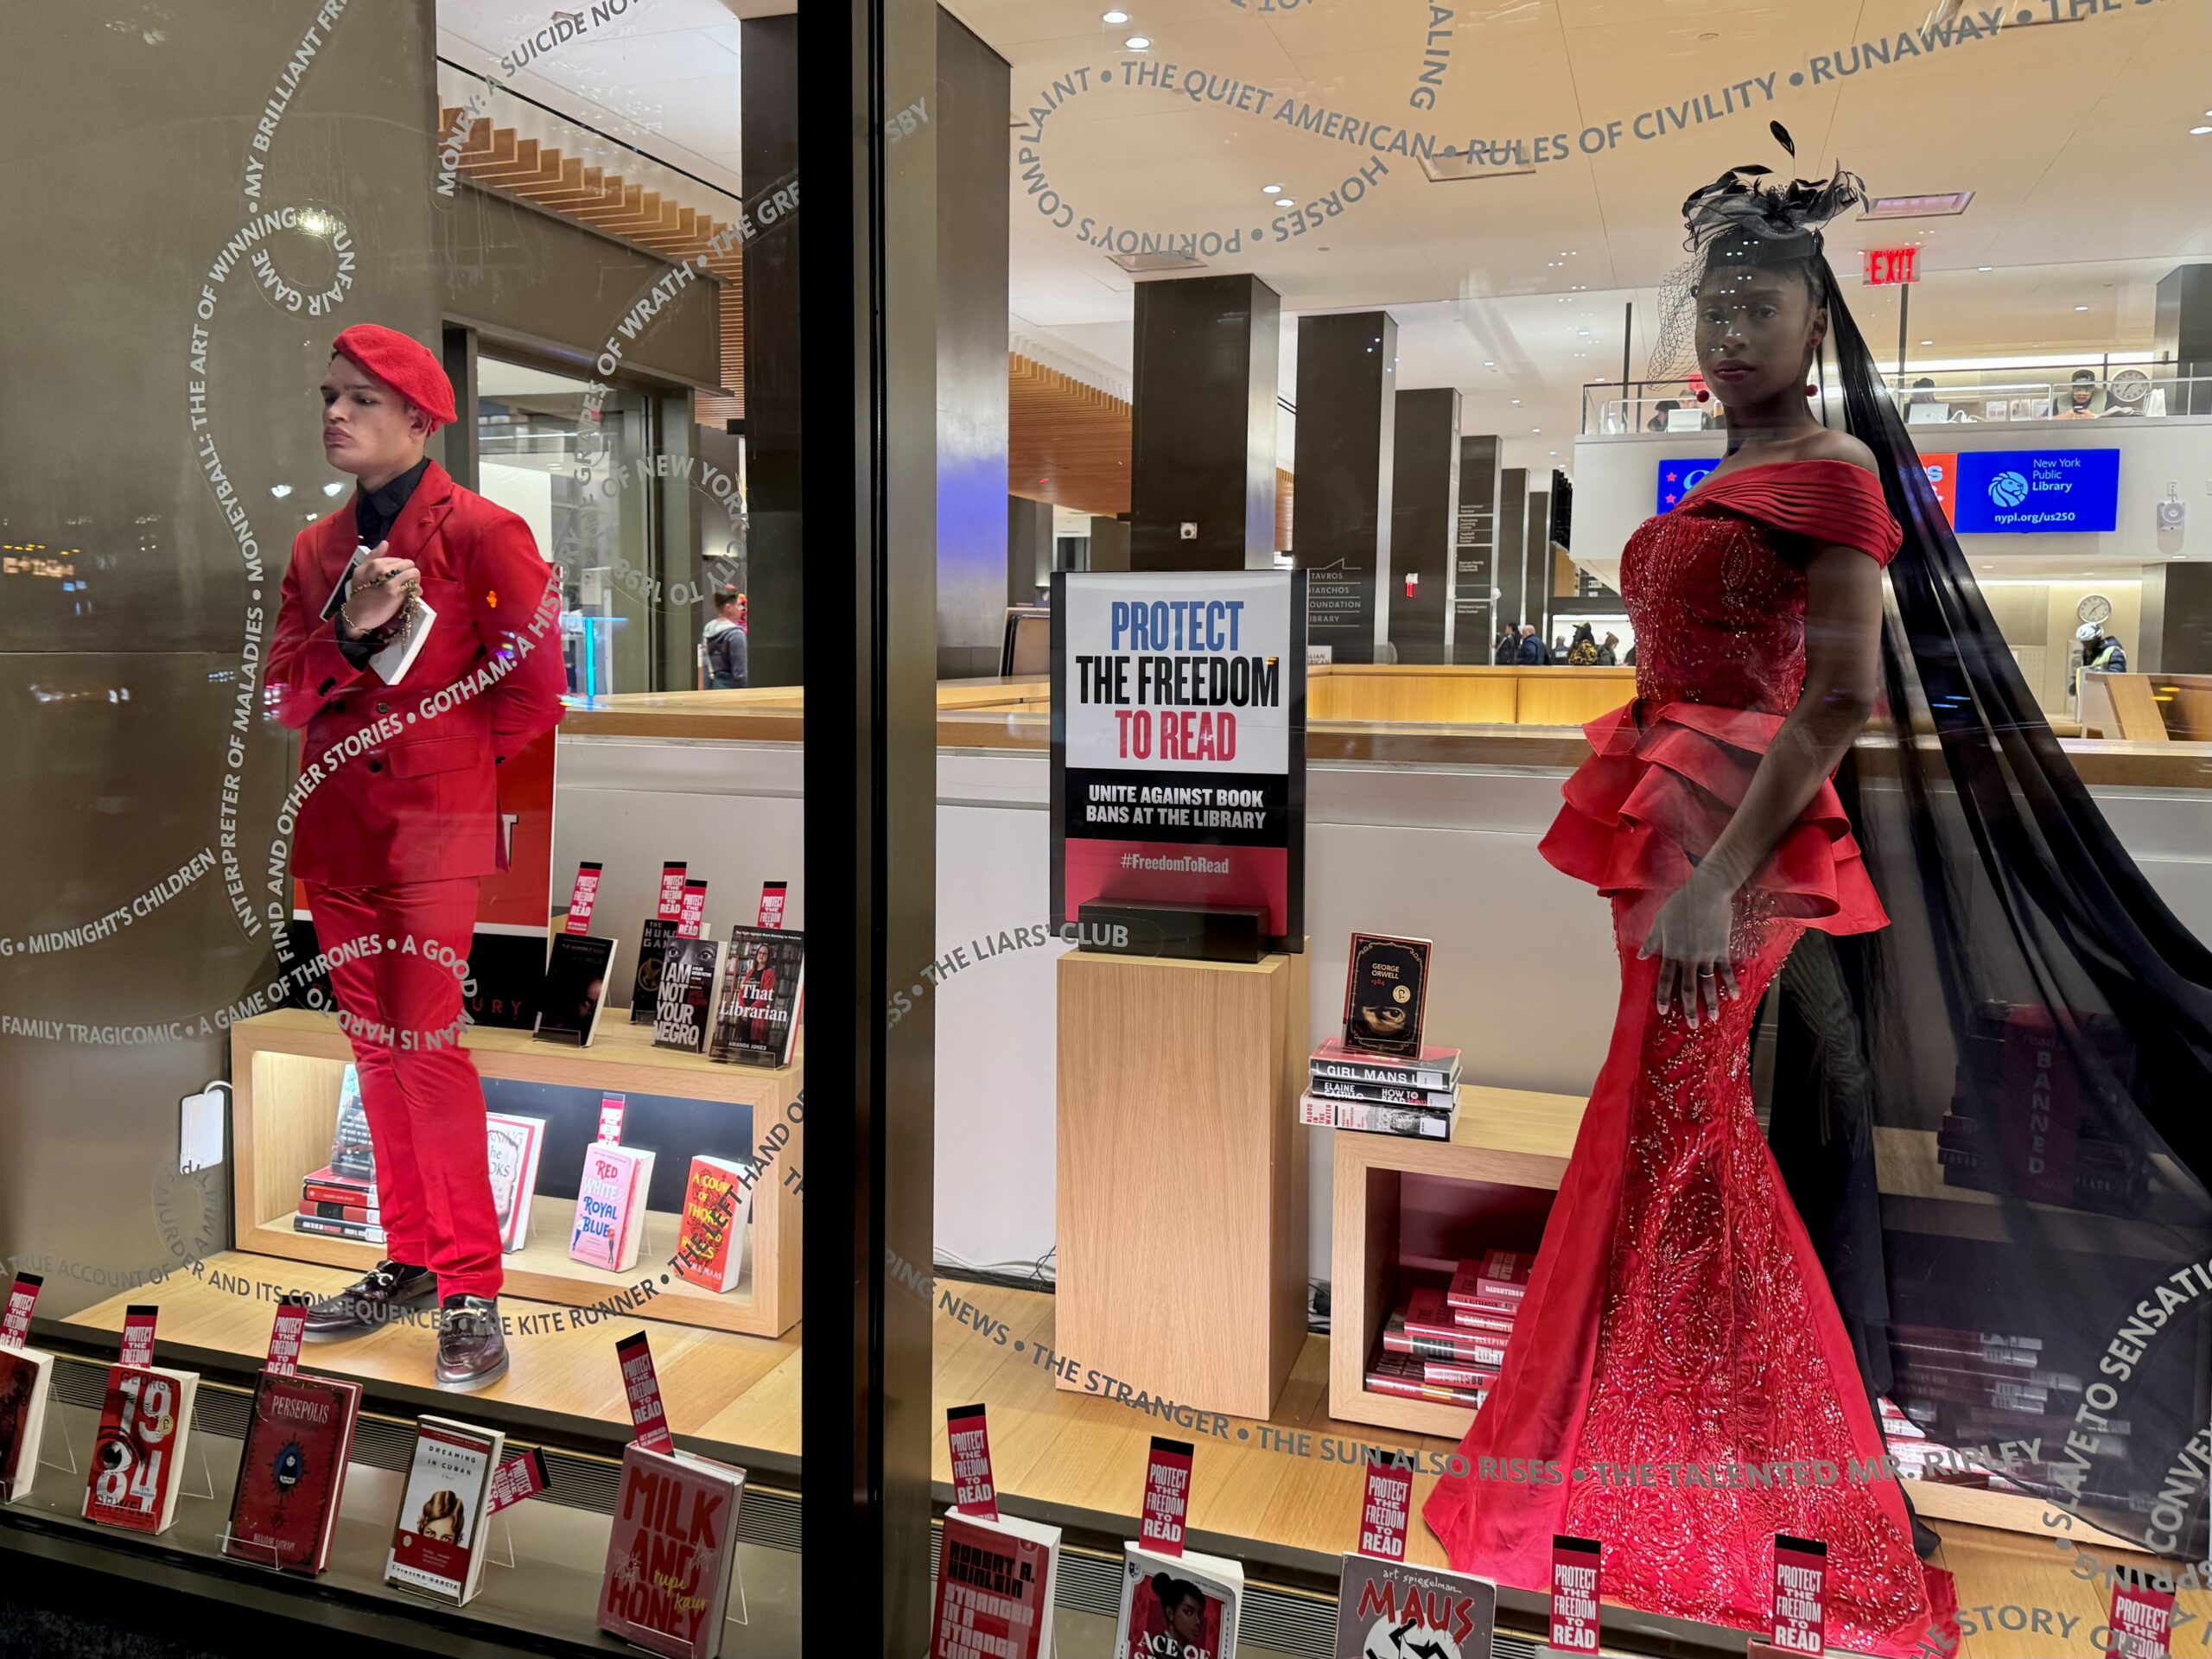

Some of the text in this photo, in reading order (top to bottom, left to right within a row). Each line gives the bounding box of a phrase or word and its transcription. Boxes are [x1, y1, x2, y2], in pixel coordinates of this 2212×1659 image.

[1809, 6, 2005, 85] RUNAWAY
[245, 26, 322, 198] MY BRILLIANT
[436, 12, 588, 197] MONEY: A SUICIDE
[1121, 61, 1437, 159] THE QUIET AMERICAN
[1465, 70, 1779, 167] RULES OF CIVILITY
[1018, 66, 1093, 229] COMPLAINT
[1271, 156, 1389, 242] HORSES
[708, 214, 755, 258] THE
[1871, 248, 1916, 283] EXIT
[596, 338, 623, 376] OF
[618, 261, 695, 341] WRATH
[189, 207, 355, 582] MONEYBALL: THE ART OF WINNING UNFAIR GAME
[636, 454, 694, 480] NEW
[2033, 458, 2081, 468] New York
[2033, 470, 2062, 480] Public
[601, 465, 630, 499] OF
[700, 461, 750, 531] YORK
[2032, 481, 2072, 493] Library
[1994, 512, 2075, 524] nypl.org/us250
[707, 538, 747, 594] CITY
[527, 529, 582, 639] HISTORY
[671, 581, 703, 605] TO
[1111, 601, 1244, 652] PROTECT
[515, 638, 534, 659] A
[419, 654, 518, 720] GOTHAM:
[1076, 656, 1279, 707] THE FREEDOM
[1116, 710, 1236, 761] TO READ
[220, 606, 264, 937] INTERPRETER OF MALADIES
[1089, 785, 1263, 807] UNITE AGAINST BOOK
[1085, 805, 1267, 829] BANS AT THE LIBRARY
[1120, 853, 1230, 874] #FreedomToRead
[267, 714, 478, 1051] A GOOD MAN IS HARD TO FIND AND OTHER STORIES
[29, 848, 216, 954] MIDNIGHT'S CHILDREN
[919, 944, 968, 987] THE
[1059, 922, 1128, 948] CLUB
[1372, 963, 1400, 972] GEORGE
[200, 934, 382, 1036] A GAME OF THRONES
[667, 963, 691, 983] AM
[1371, 969, 1399, 979] ORWELL
[658, 984, 689, 1001] NOT
[742, 984, 774, 1001] That
[657, 1003, 694, 1024] YOUR
[720, 1001, 788, 1022] Librarian
[2, 1014, 181, 1046] FAMILY TRAGICOMIC
[654, 1020, 700, 1046] NEGRO
[1325, 1082, 1355, 1092] ELAINE
[1327, 1065, 1407, 1083] GIRL MANS
[2029, 1052, 2052, 1173] BANNED
[596, 1160, 618, 1179] RED
[583, 1177, 618, 1200] WHITE
[668, 1233, 709, 1276] THE
[702, 1185, 742, 1240] LEFT
[736, 1123, 790, 1190] HAND
[584, 1196, 617, 1219] ROYAL
[583, 1216, 609, 1237] BLUE
[57, 1260, 143, 1288] ACCOUNT
[149, 1262, 170, 1285] OF
[207, 1270, 251, 1297] AND
[256, 1282, 283, 1302] ITS
[518, 1279, 659, 1335] KITE RUNNER
[939, 1290, 1010, 1345] NEWS
[1032, 1341, 1230, 1439] THE STRANGER
[272, 1395, 329, 1424] PERSEPOLIS
[429, 1446, 475, 1464] DREAMING
[442, 1462, 471, 1476] CUBAN
[1256, 1425, 1564, 1484] THE SUN ALSO RISES
[1592, 1464, 1656, 1487] THE
[1664, 1459, 1839, 1490] TALENTED
[1925, 1438, 2042, 1477] RIPLEY
[2043, 1430, 2100, 1531] SLAVE
[2075, 1382, 2118, 1425] TO
[1150, 1464, 1188, 1490] PROTECT
[1155, 1485, 1179, 1497] THE
[623, 1465, 723, 1548] MILK
[1147, 1492, 1184, 1516] FREEDOM
[1156, 1512, 1172, 1522] TO
[1143, 1519, 1182, 1542] READ
[630, 1529, 702, 1598] AND
[1777, 1563, 1821, 1591] PROTECT
[1382, 1568, 1461, 1595] art spiegelman
[1784, 1587, 1815, 1600] THE
[607, 1576, 706, 1645] HONEY
[1357, 1577, 1474, 1645] MAUS
[1776, 1596, 1821, 1621] FREEDOM
[1789, 1618, 1808, 1628] TO
[1954, 1605, 2080, 1639] STORY
[1139, 1631, 1179, 1657] ACE
[1775, 1626, 1820, 1652] READ
